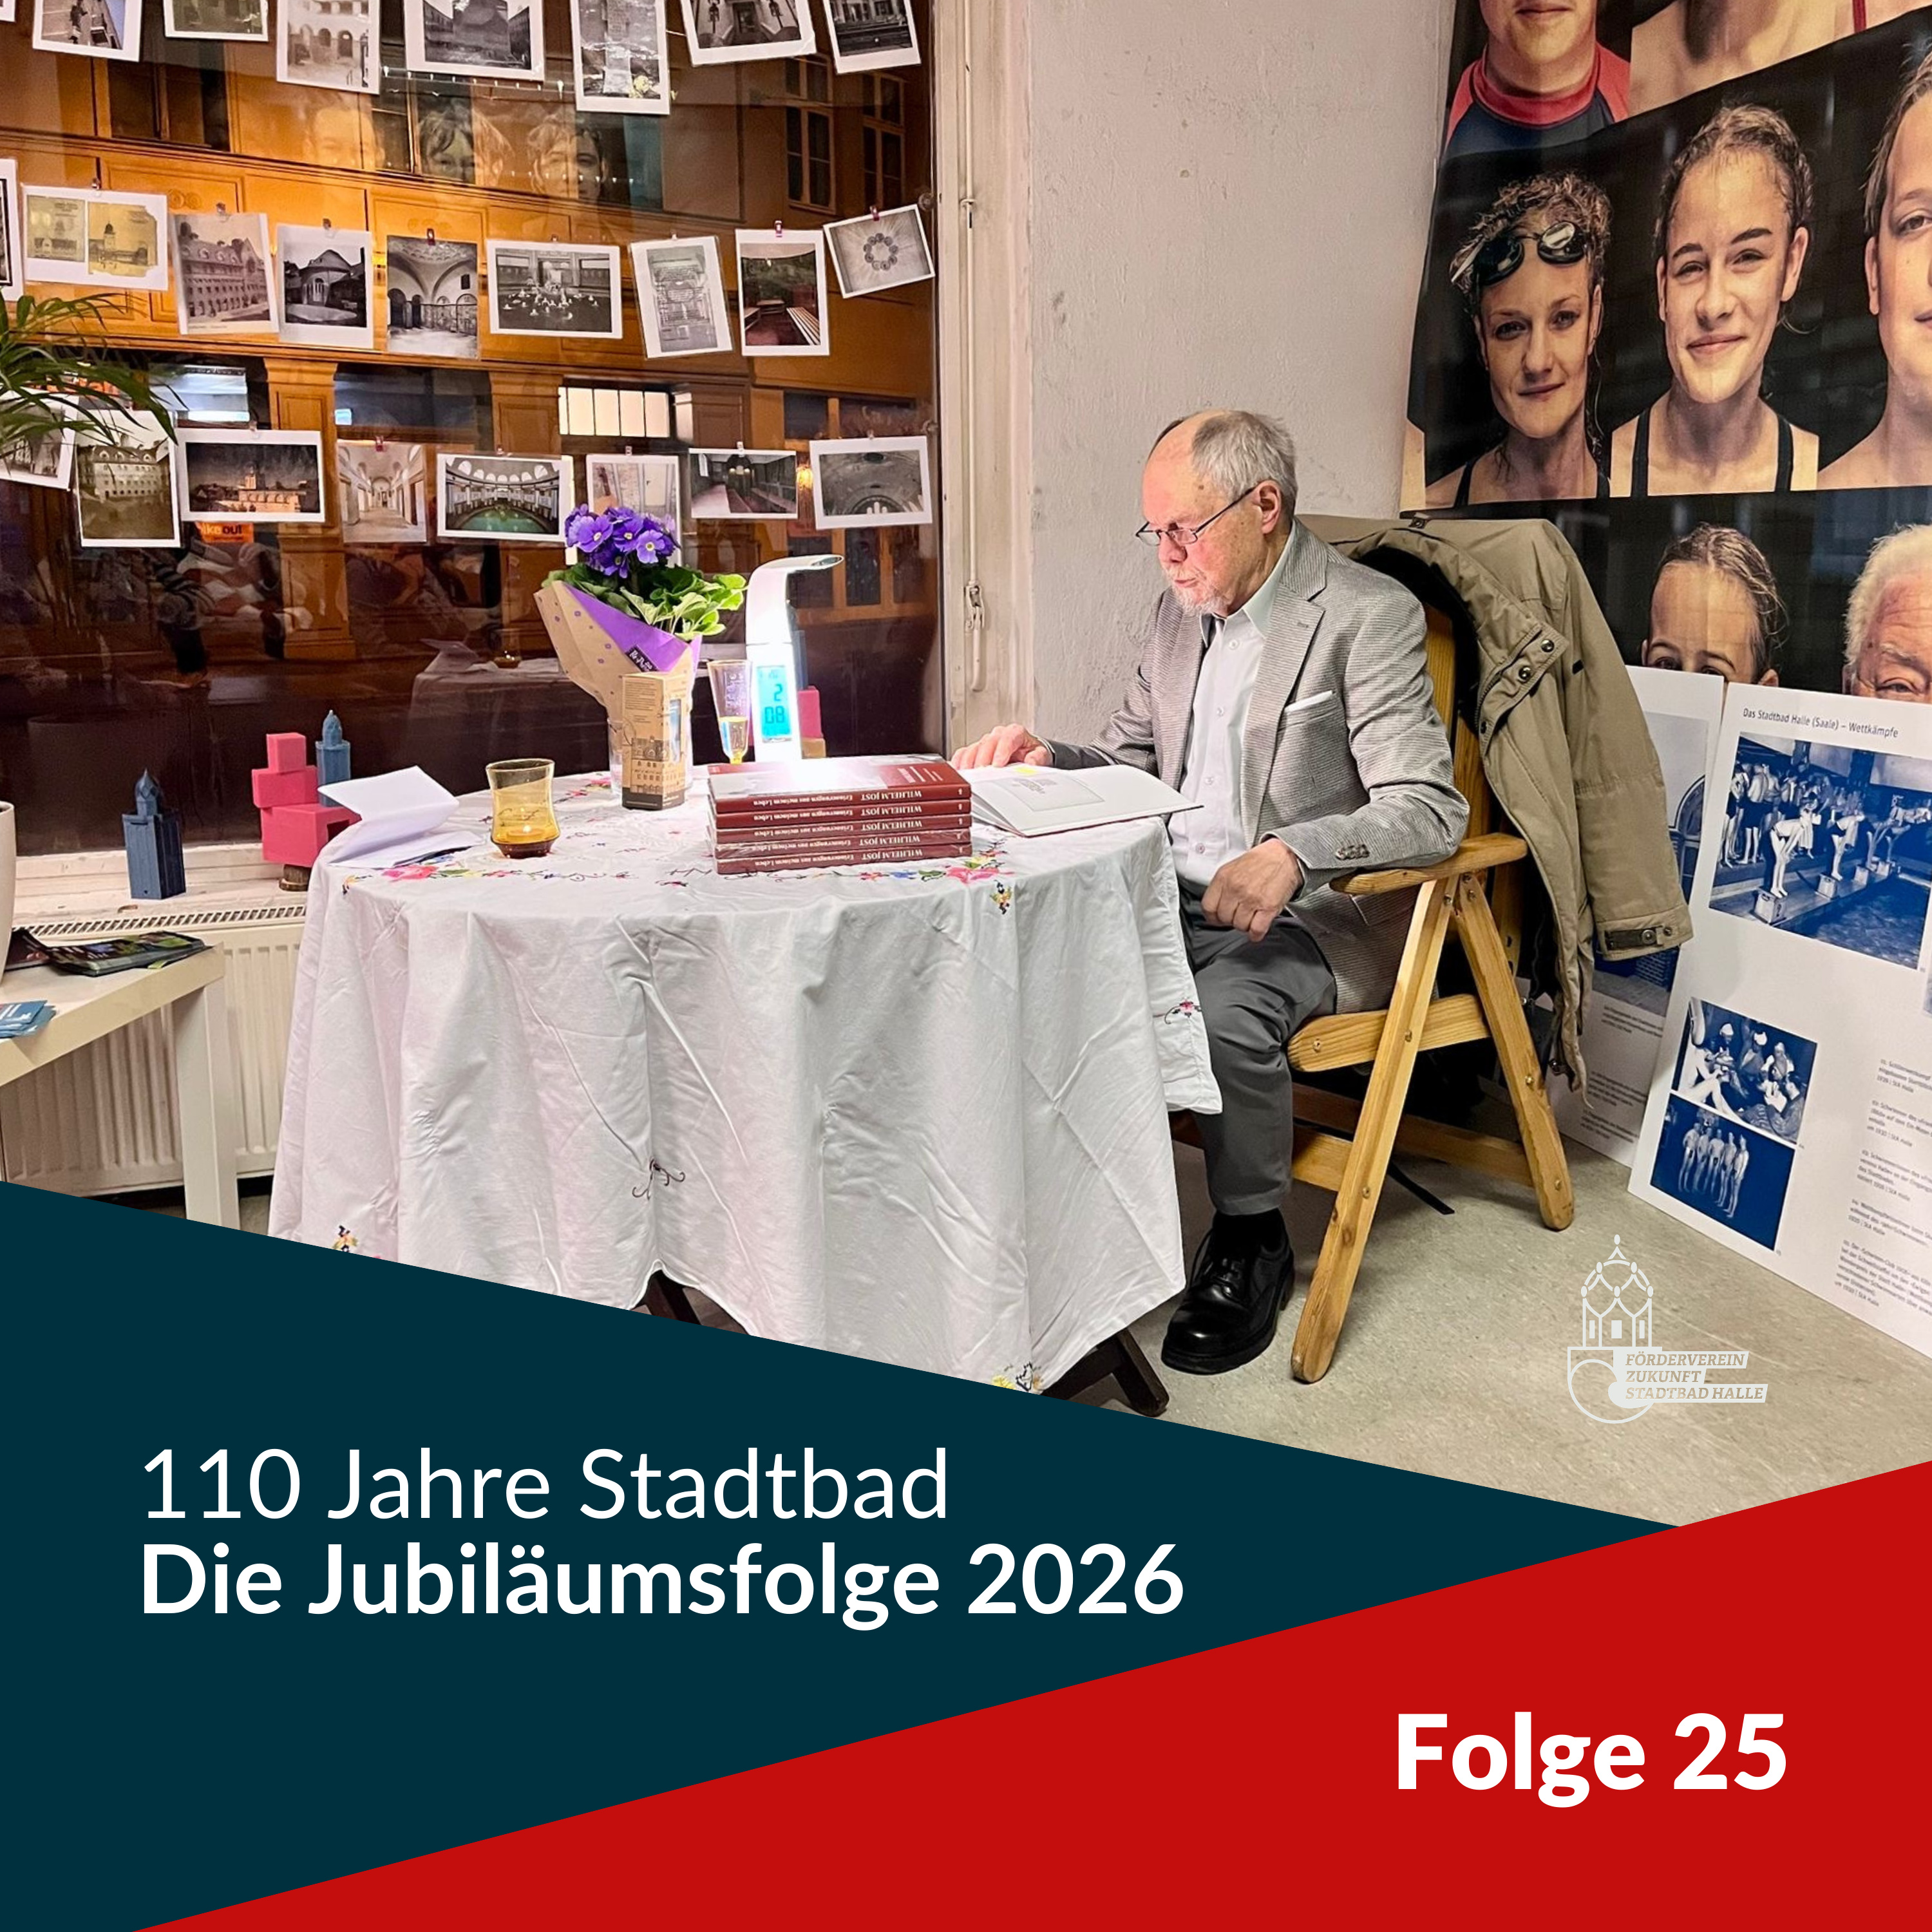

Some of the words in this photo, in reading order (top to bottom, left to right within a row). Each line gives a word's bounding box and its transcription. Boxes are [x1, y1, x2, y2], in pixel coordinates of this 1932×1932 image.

[1743, 708, 1756, 718] Das
[1757, 710, 1789, 723] Stadtbad
[1792, 714, 1810, 726] Halle
[1812, 716, 1839, 730] (Saale)
[1848, 722, 1899, 739] Wettkämpfe
[860, 792, 880, 801] JOST
[881, 790, 922, 799] WILHELM
[860, 807, 880, 816] JOST
[881, 805, 922, 815] WILHELM
[861, 822, 881, 831] JOST
[882, 820, 922, 829] WILHELM
[859, 837, 878, 846] JOST
[879, 835, 920, 844] WILHELM
[862, 851, 881, 860] JOST
[882, 849, 923, 858] WILHELM
